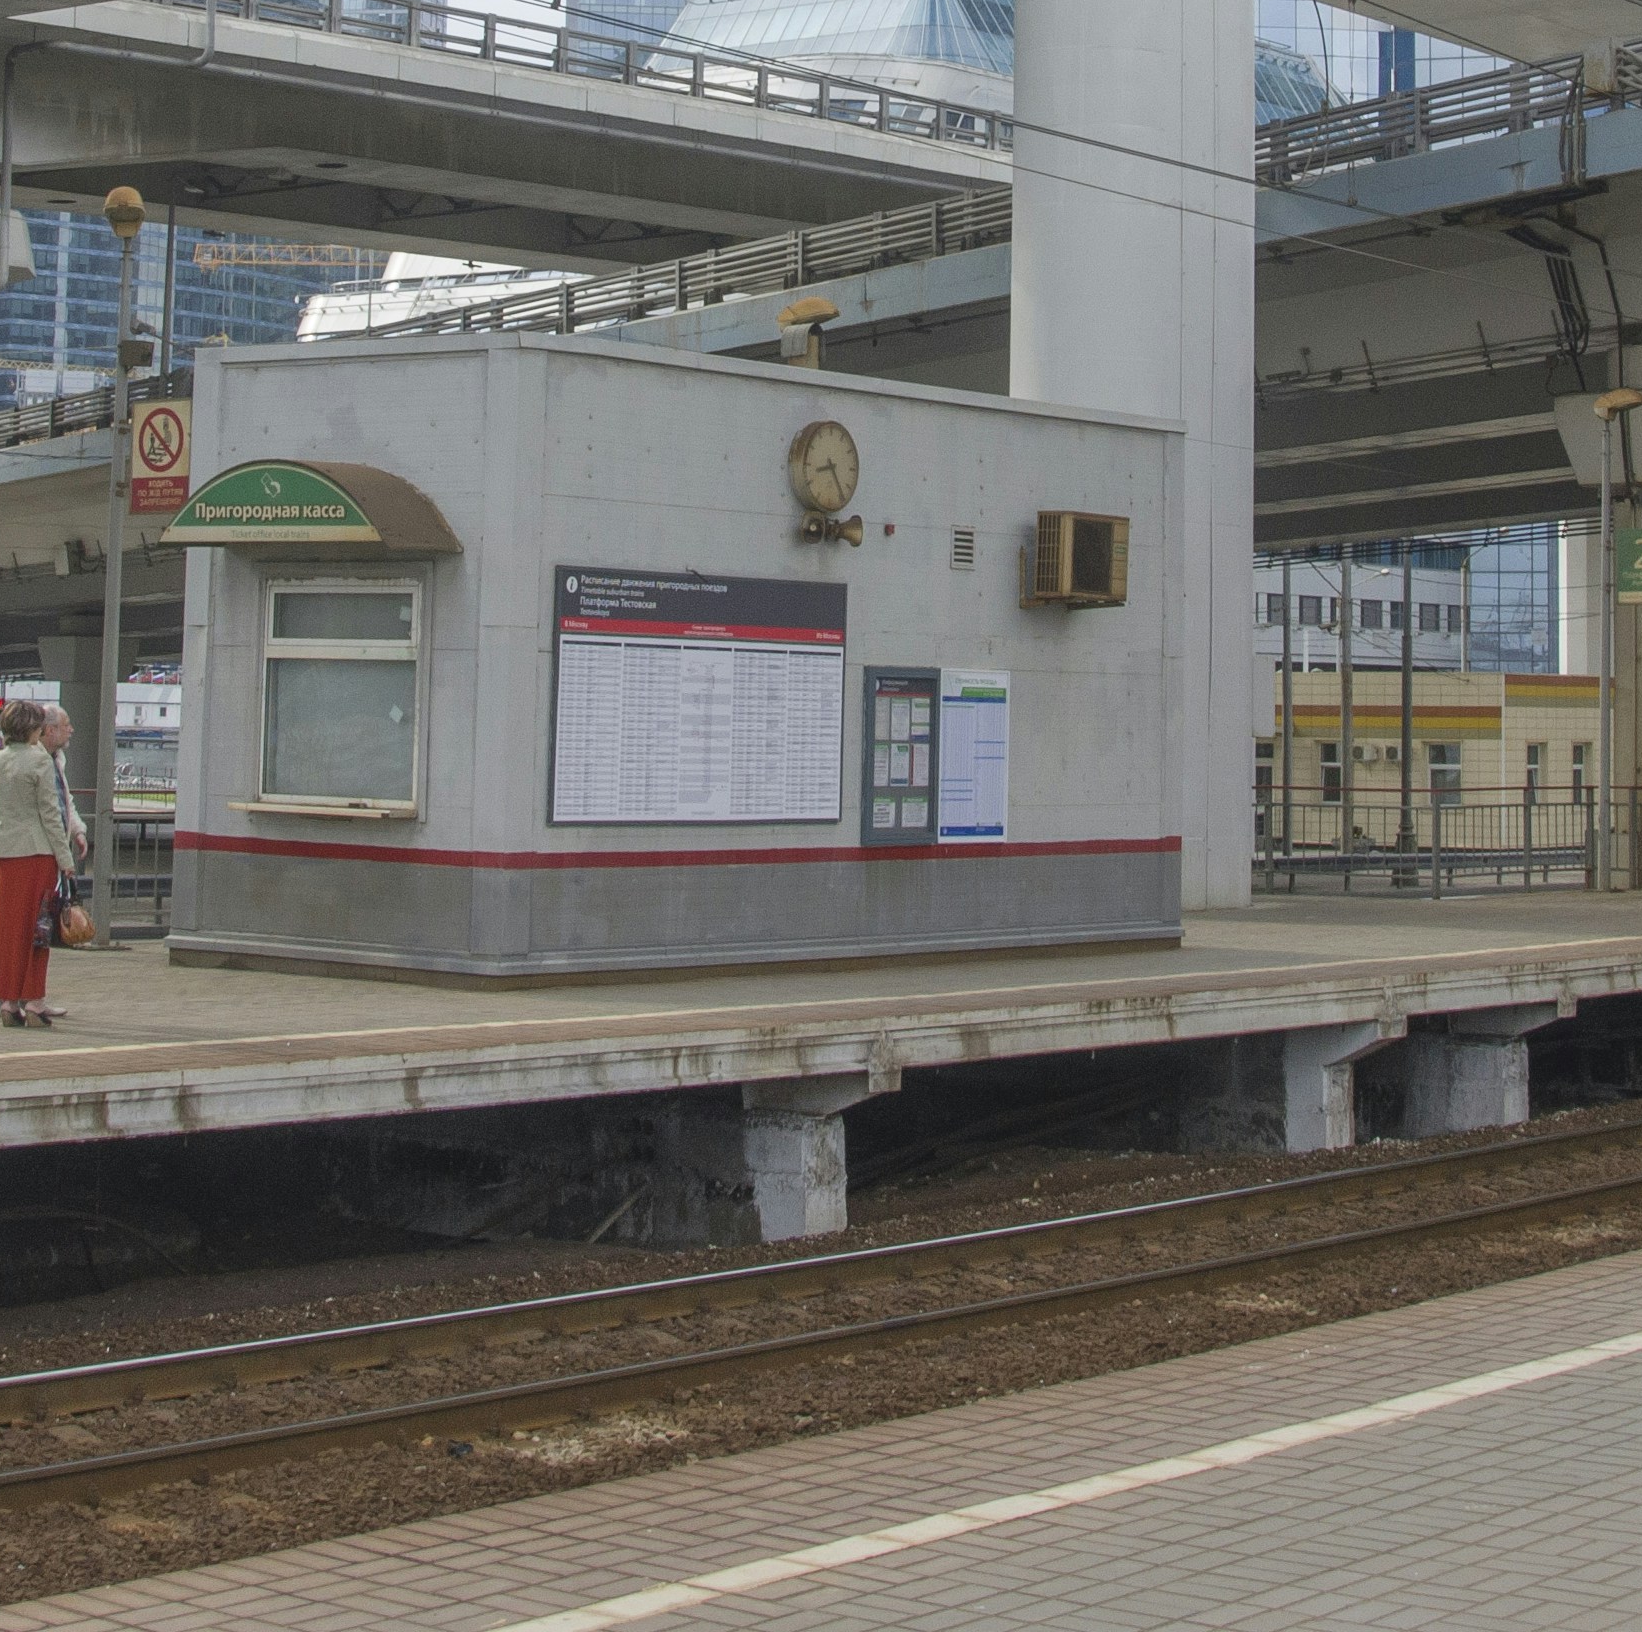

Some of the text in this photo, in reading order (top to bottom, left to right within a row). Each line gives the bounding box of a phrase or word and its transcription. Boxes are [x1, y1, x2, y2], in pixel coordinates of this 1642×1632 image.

[195, 502, 345, 522] Пригородная касса
[230, 529, 252, 538] Ticket
[252, 529, 272, 538] office
[273, 529, 289, 538] local
[580, 574, 728, 593] Расписание движения пригородных поездов
[580, 596, 657, 609] Платформа Тестовская
